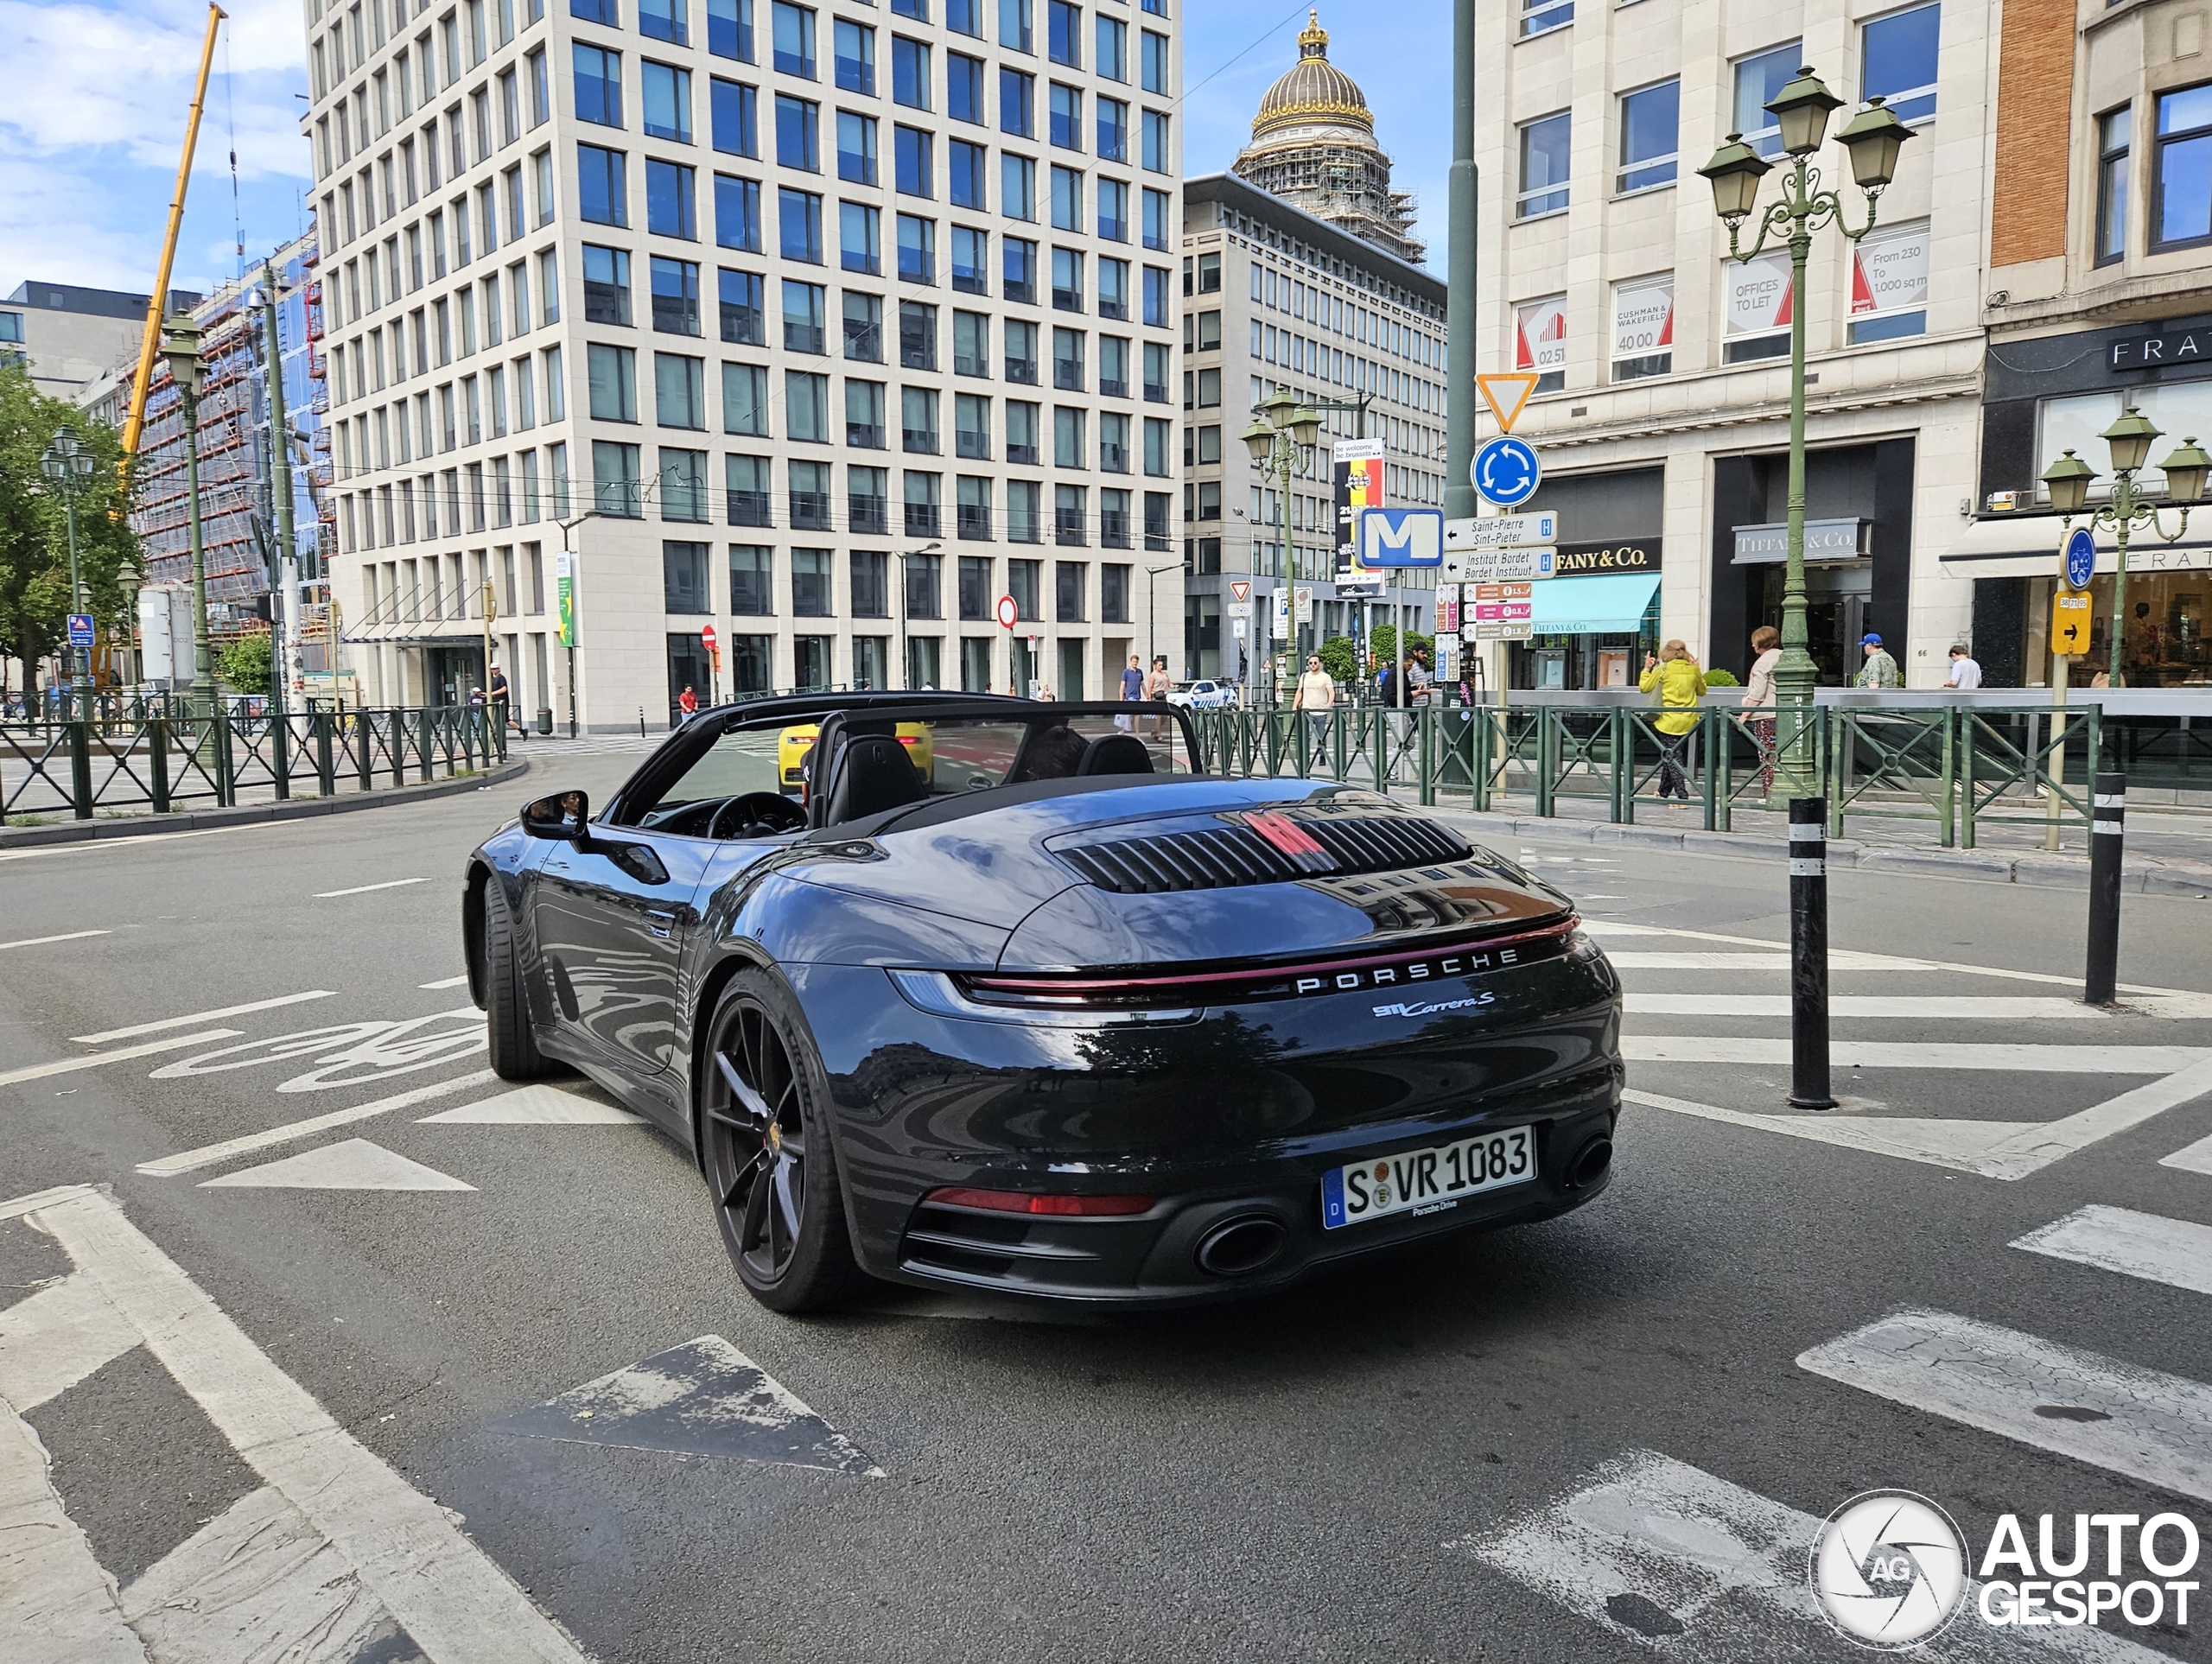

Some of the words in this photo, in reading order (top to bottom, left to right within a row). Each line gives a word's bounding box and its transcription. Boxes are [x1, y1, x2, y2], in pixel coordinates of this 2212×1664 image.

[1873, 252, 1899, 264] From
[1901, 246, 1921, 260] 230
[1873, 269, 1885, 279] To
[1736, 278, 1778, 297] OFFICES
[1874, 279, 1902, 293] 1.000
[1904, 278, 1915, 289] sq
[1736, 299, 1751, 312] TO
[1752, 295, 1771, 309] LET
[1618, 306, 1658, 320] CUSHMAN
[1618, 312, 1667, 327] WAKEFIELD
[1618, 335, 1635, 351] 40
[1637, 332, 1653, 348] 00
[1539, 350, 1553, 365] 02
[1471, 518, 1523, 532] Saint-Pierre
[1473, 532, 1522, 545] Sint-Pieter
[1808, 536, 1821, 549] &
[1466, 554, 1497, 566] Institut
[1501, 552, 1529, 564] Bordet
[1599, 549, 1615, 567] &
[1465, 566, 1492, 579] Bordet
[1496, 564, 1532, 577] Instituut
[1533, 623, 1565, 632] TIFFANY
[1297, 949, 1518, 994] PORSCHE
[1402, 997, 1477, 1017] Carrera
[1477, 991, 1496, 1006] S
[1331, 1202, 1339, 1216] D
[1347, 1169, 1370, 1215] S
[1446, 1132, 1528, 1192] 1083
[1412, 1203, 1440, 1217] Porsche
[1440, 1199, 1459, 1212] Drive
